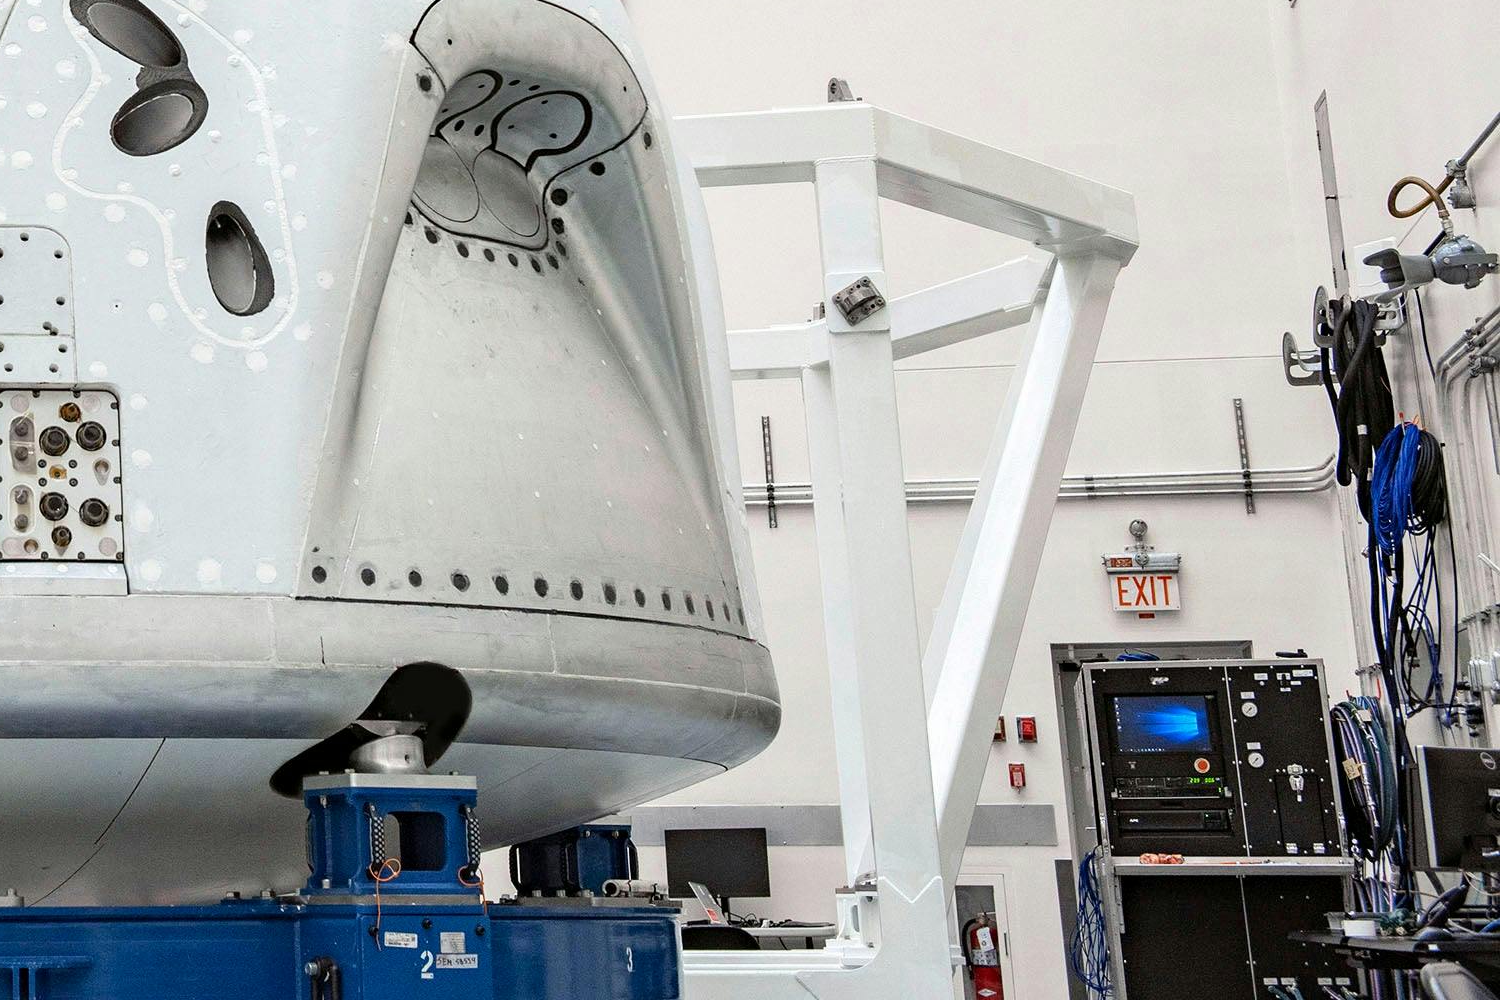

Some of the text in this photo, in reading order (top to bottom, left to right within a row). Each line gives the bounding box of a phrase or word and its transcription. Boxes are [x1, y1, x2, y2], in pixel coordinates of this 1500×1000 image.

[1116, 575, 1173, 606] EXIT
[420, 950, 434, 979] 2
[626, 946, 633, 973] 3
